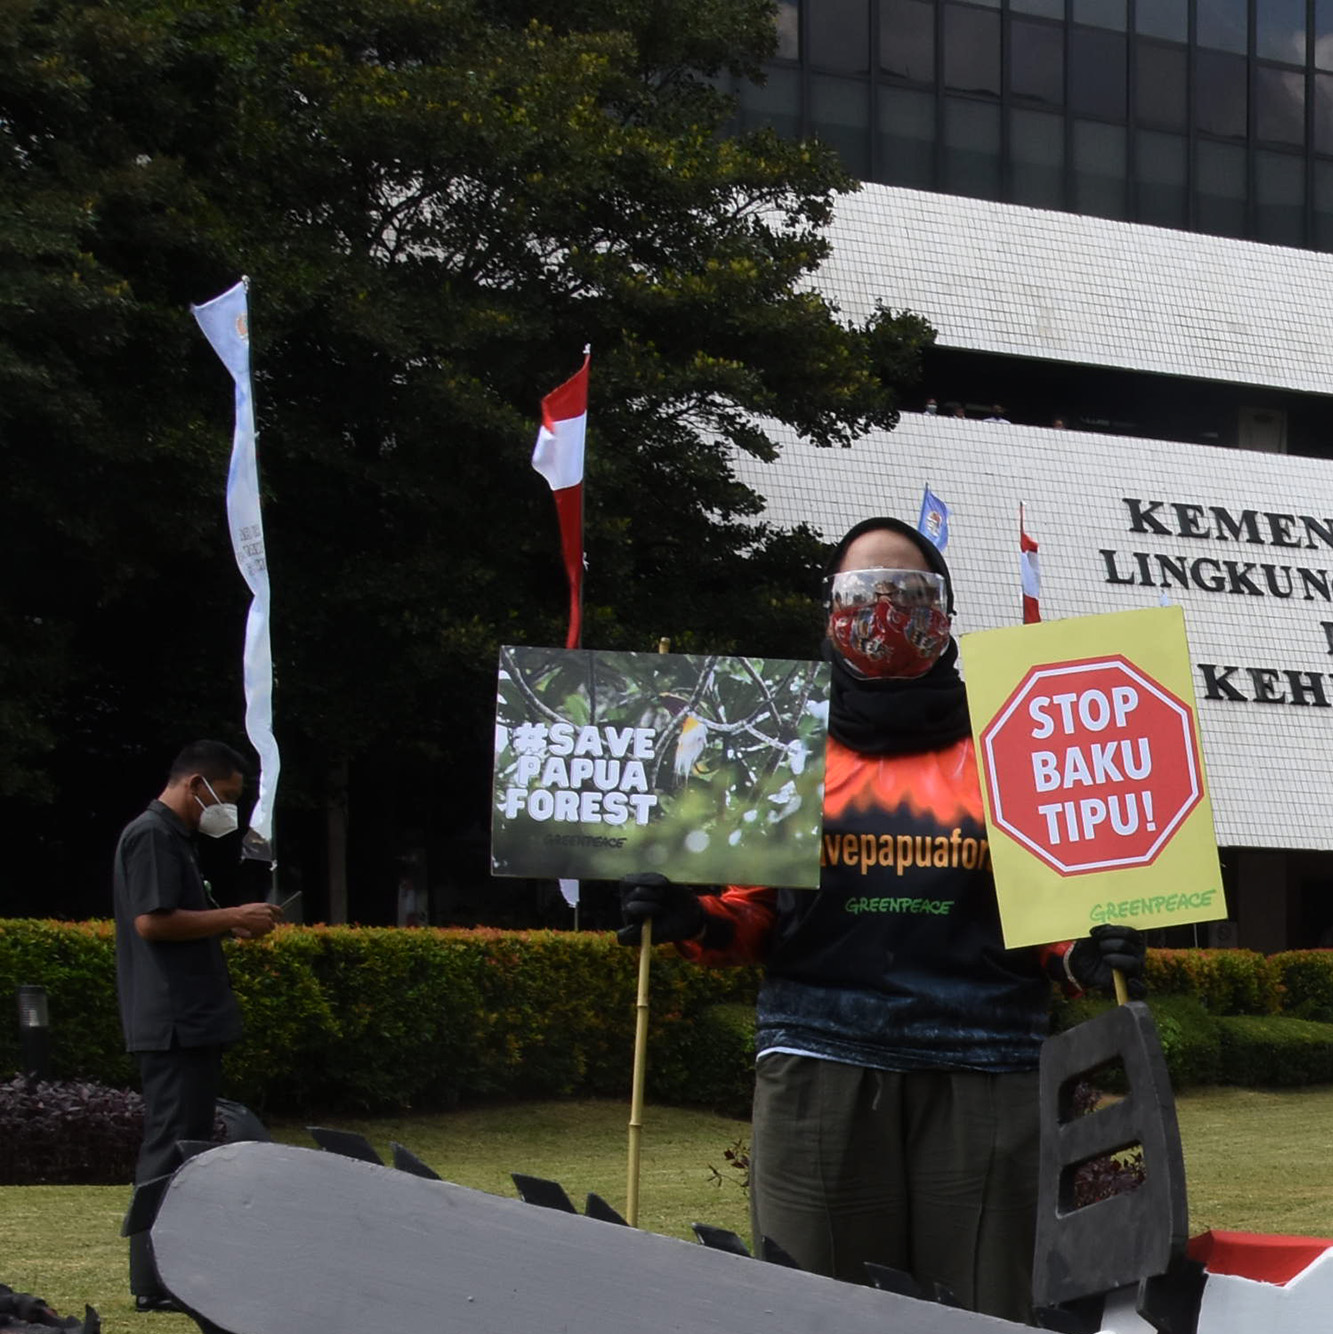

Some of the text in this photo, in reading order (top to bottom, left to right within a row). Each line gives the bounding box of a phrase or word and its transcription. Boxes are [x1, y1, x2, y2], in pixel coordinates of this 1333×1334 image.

[1029, 686, 1139, 739] STOP
[512, 722, 656, 760] #SAVE
[516, 755, 649, 793] PAPUA
[1031, 738, 1152, 793] BAKU
[505, 788, 657, 827] FOREST
[1038, 791, 1157, 845] TIPU!
[543, 833, 627, 849] GREENPEACE
[845, 897, 955, 915] GREENPEACE
[1089, 889, 1217, 924] GREENPEACE
